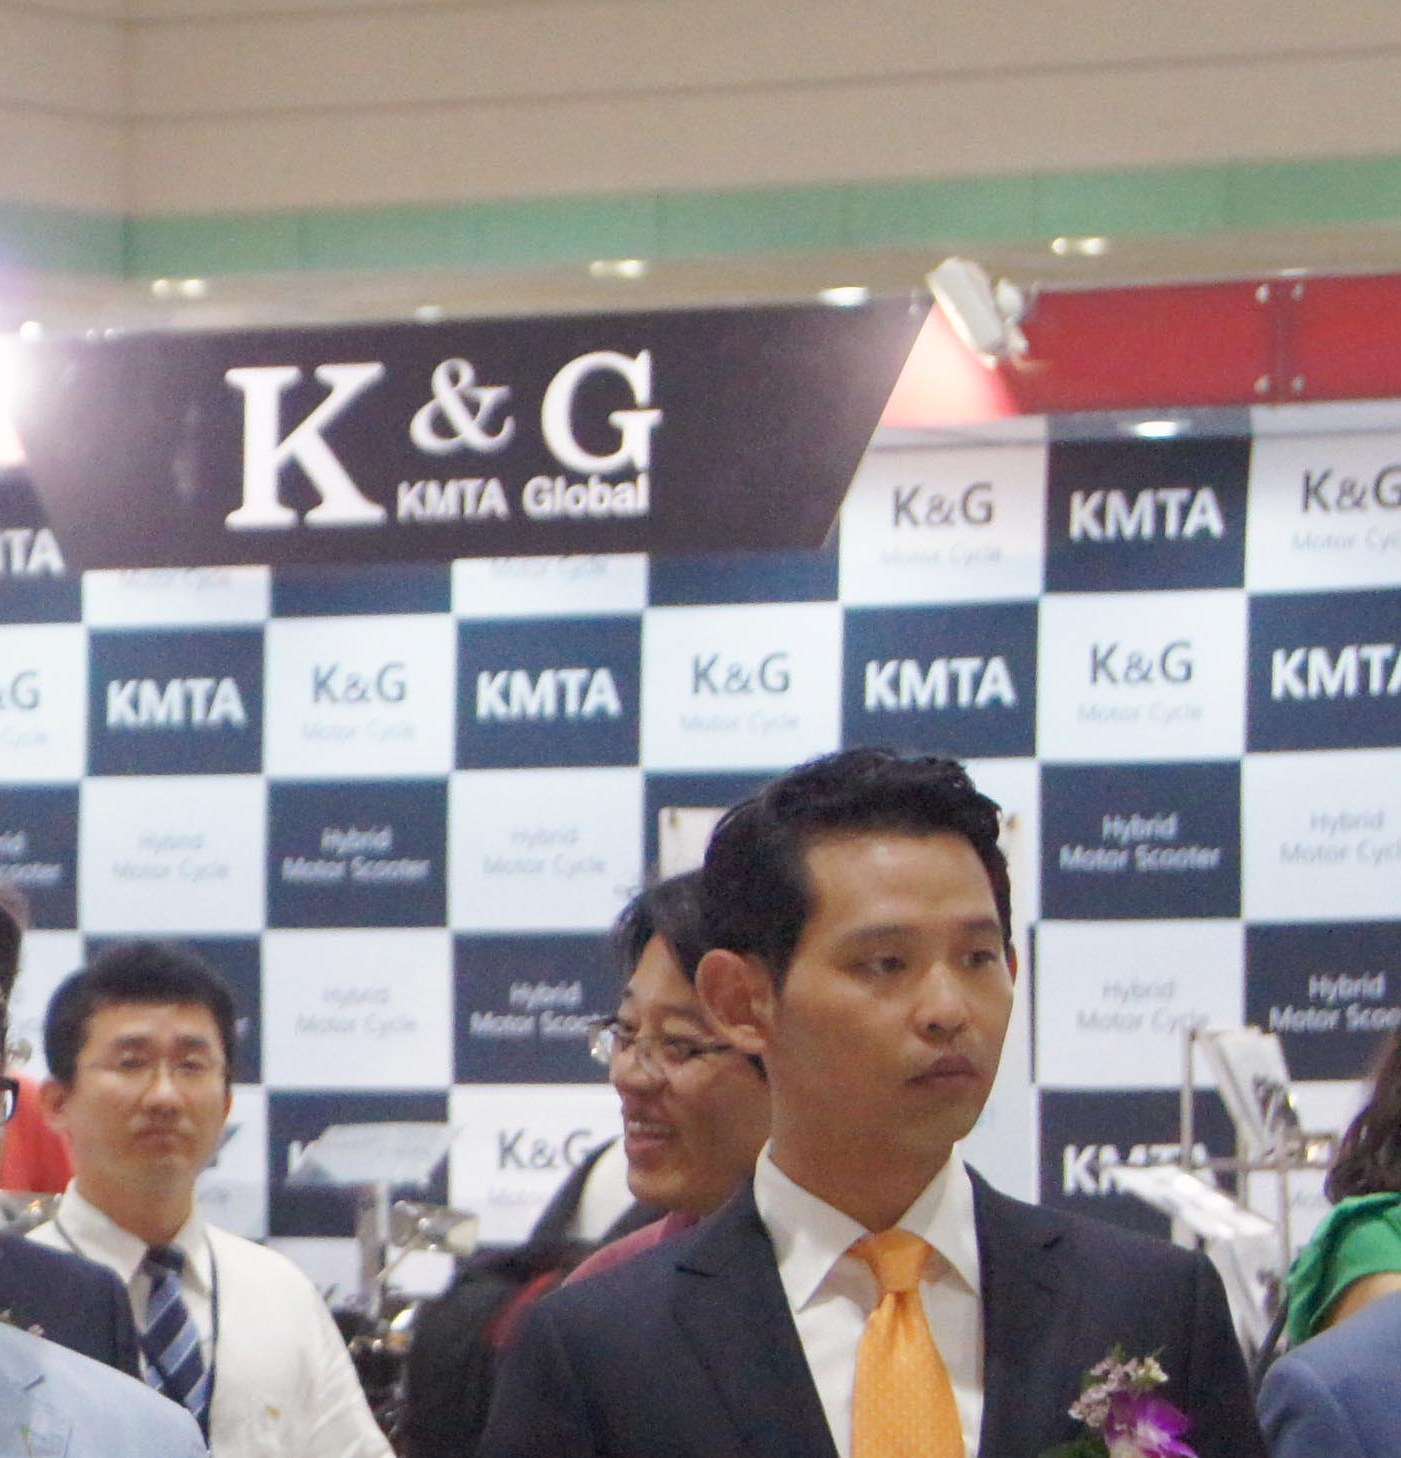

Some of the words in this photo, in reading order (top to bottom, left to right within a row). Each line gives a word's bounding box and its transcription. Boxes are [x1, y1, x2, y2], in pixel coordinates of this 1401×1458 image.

[397, 477, 511, 523] KMTA
[522, 472, 651, 521] Global
[890, 481, 996, 530] K&G
[1068, 486, 1227, 544] KMTA
[310, 661, 409, 706] K&G
[689, 651, 792, 698] K&G
[863, 655, 1020, 713] KMTA
[1088, 639, 1196, 689] K&G
[105, 676, 248, 732] KMTA
[475, 667, 624, 723] KMTA
[1101, 811, 1180, 847] Hybrid
[281, 856, 347, 884] Motor
[350, 855, 431, 884] Scooter
[1059, 843, 1130, 872] Motor
[1134, 843, 1222, 872] Scooter
[509, 979, 583, 1012] Hybrid
[1308, 969, 1387, 1006] Hybrid
[469, 1010, 536, 1038] Motor
[1268, 1004, 1342, 1034] Motor
[1345, 1003, 1401, 1033] Scoo
